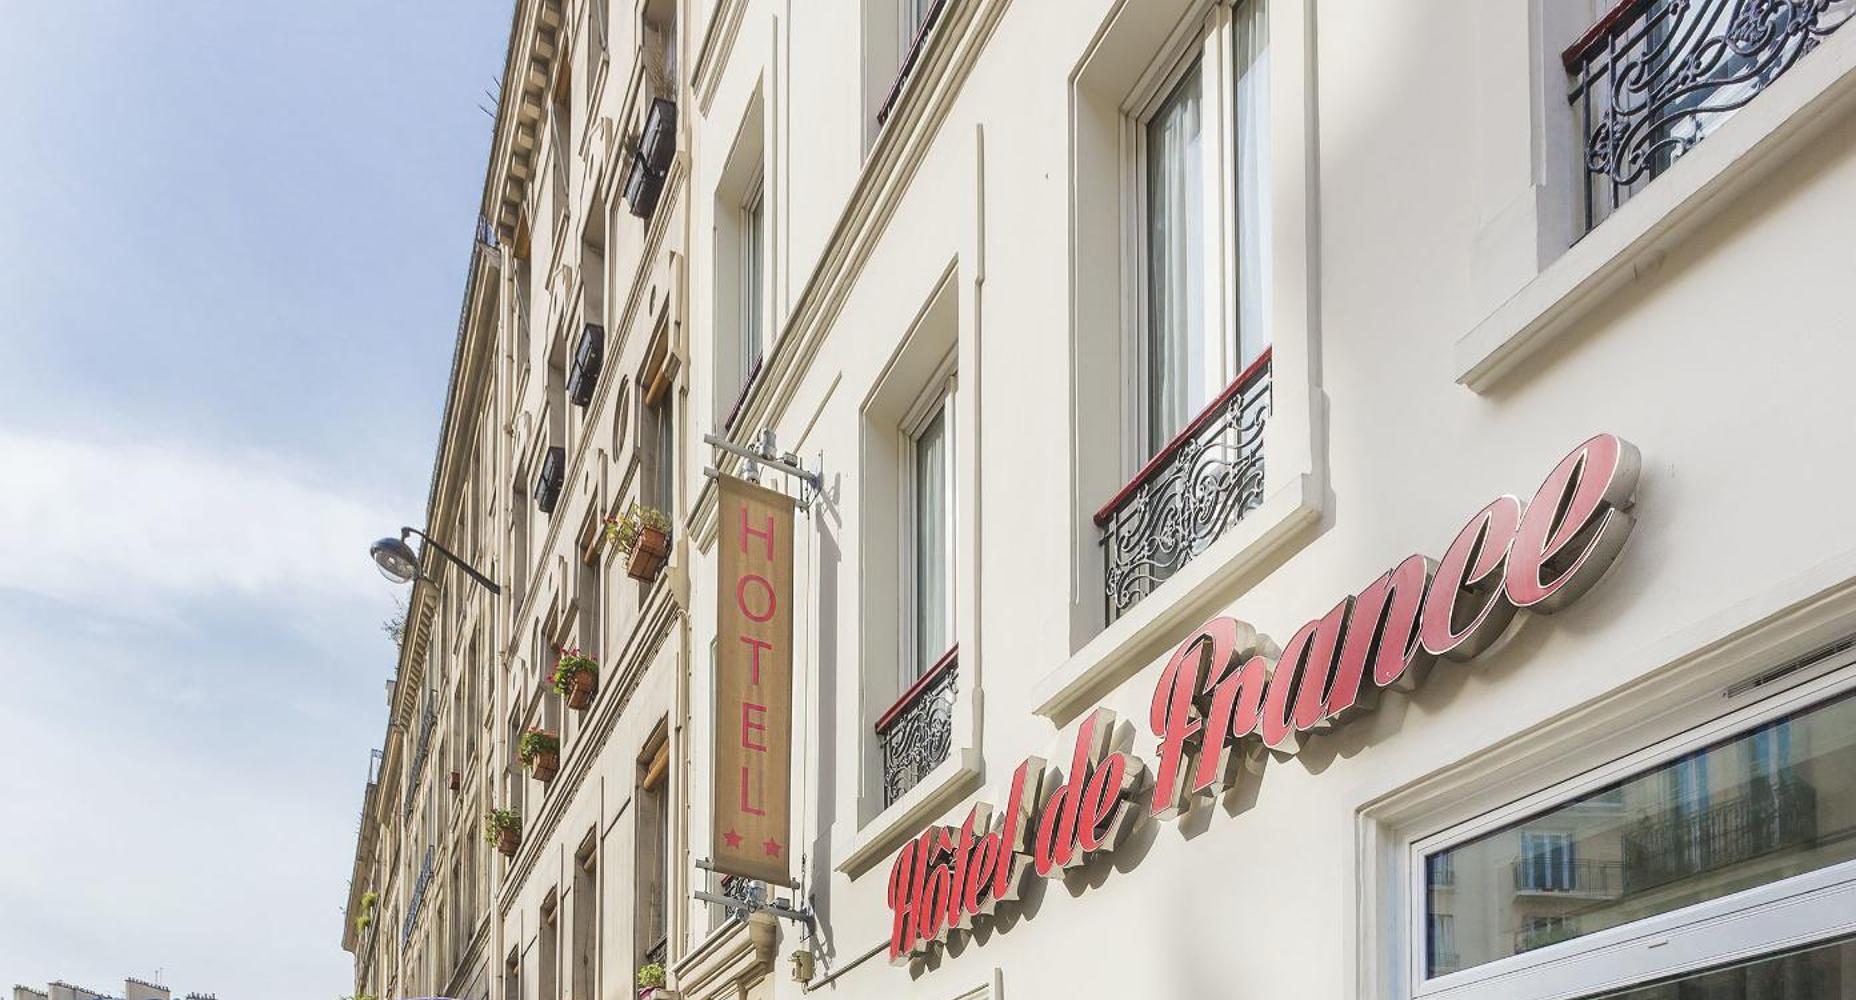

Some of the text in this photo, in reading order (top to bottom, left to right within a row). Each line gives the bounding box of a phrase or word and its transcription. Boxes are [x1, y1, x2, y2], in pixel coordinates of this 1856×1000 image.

[736, 504, 778, 817] HOTEL
[887, 756, 1029, 963] Hôtel
[1033, 707, 1125, 878] de
